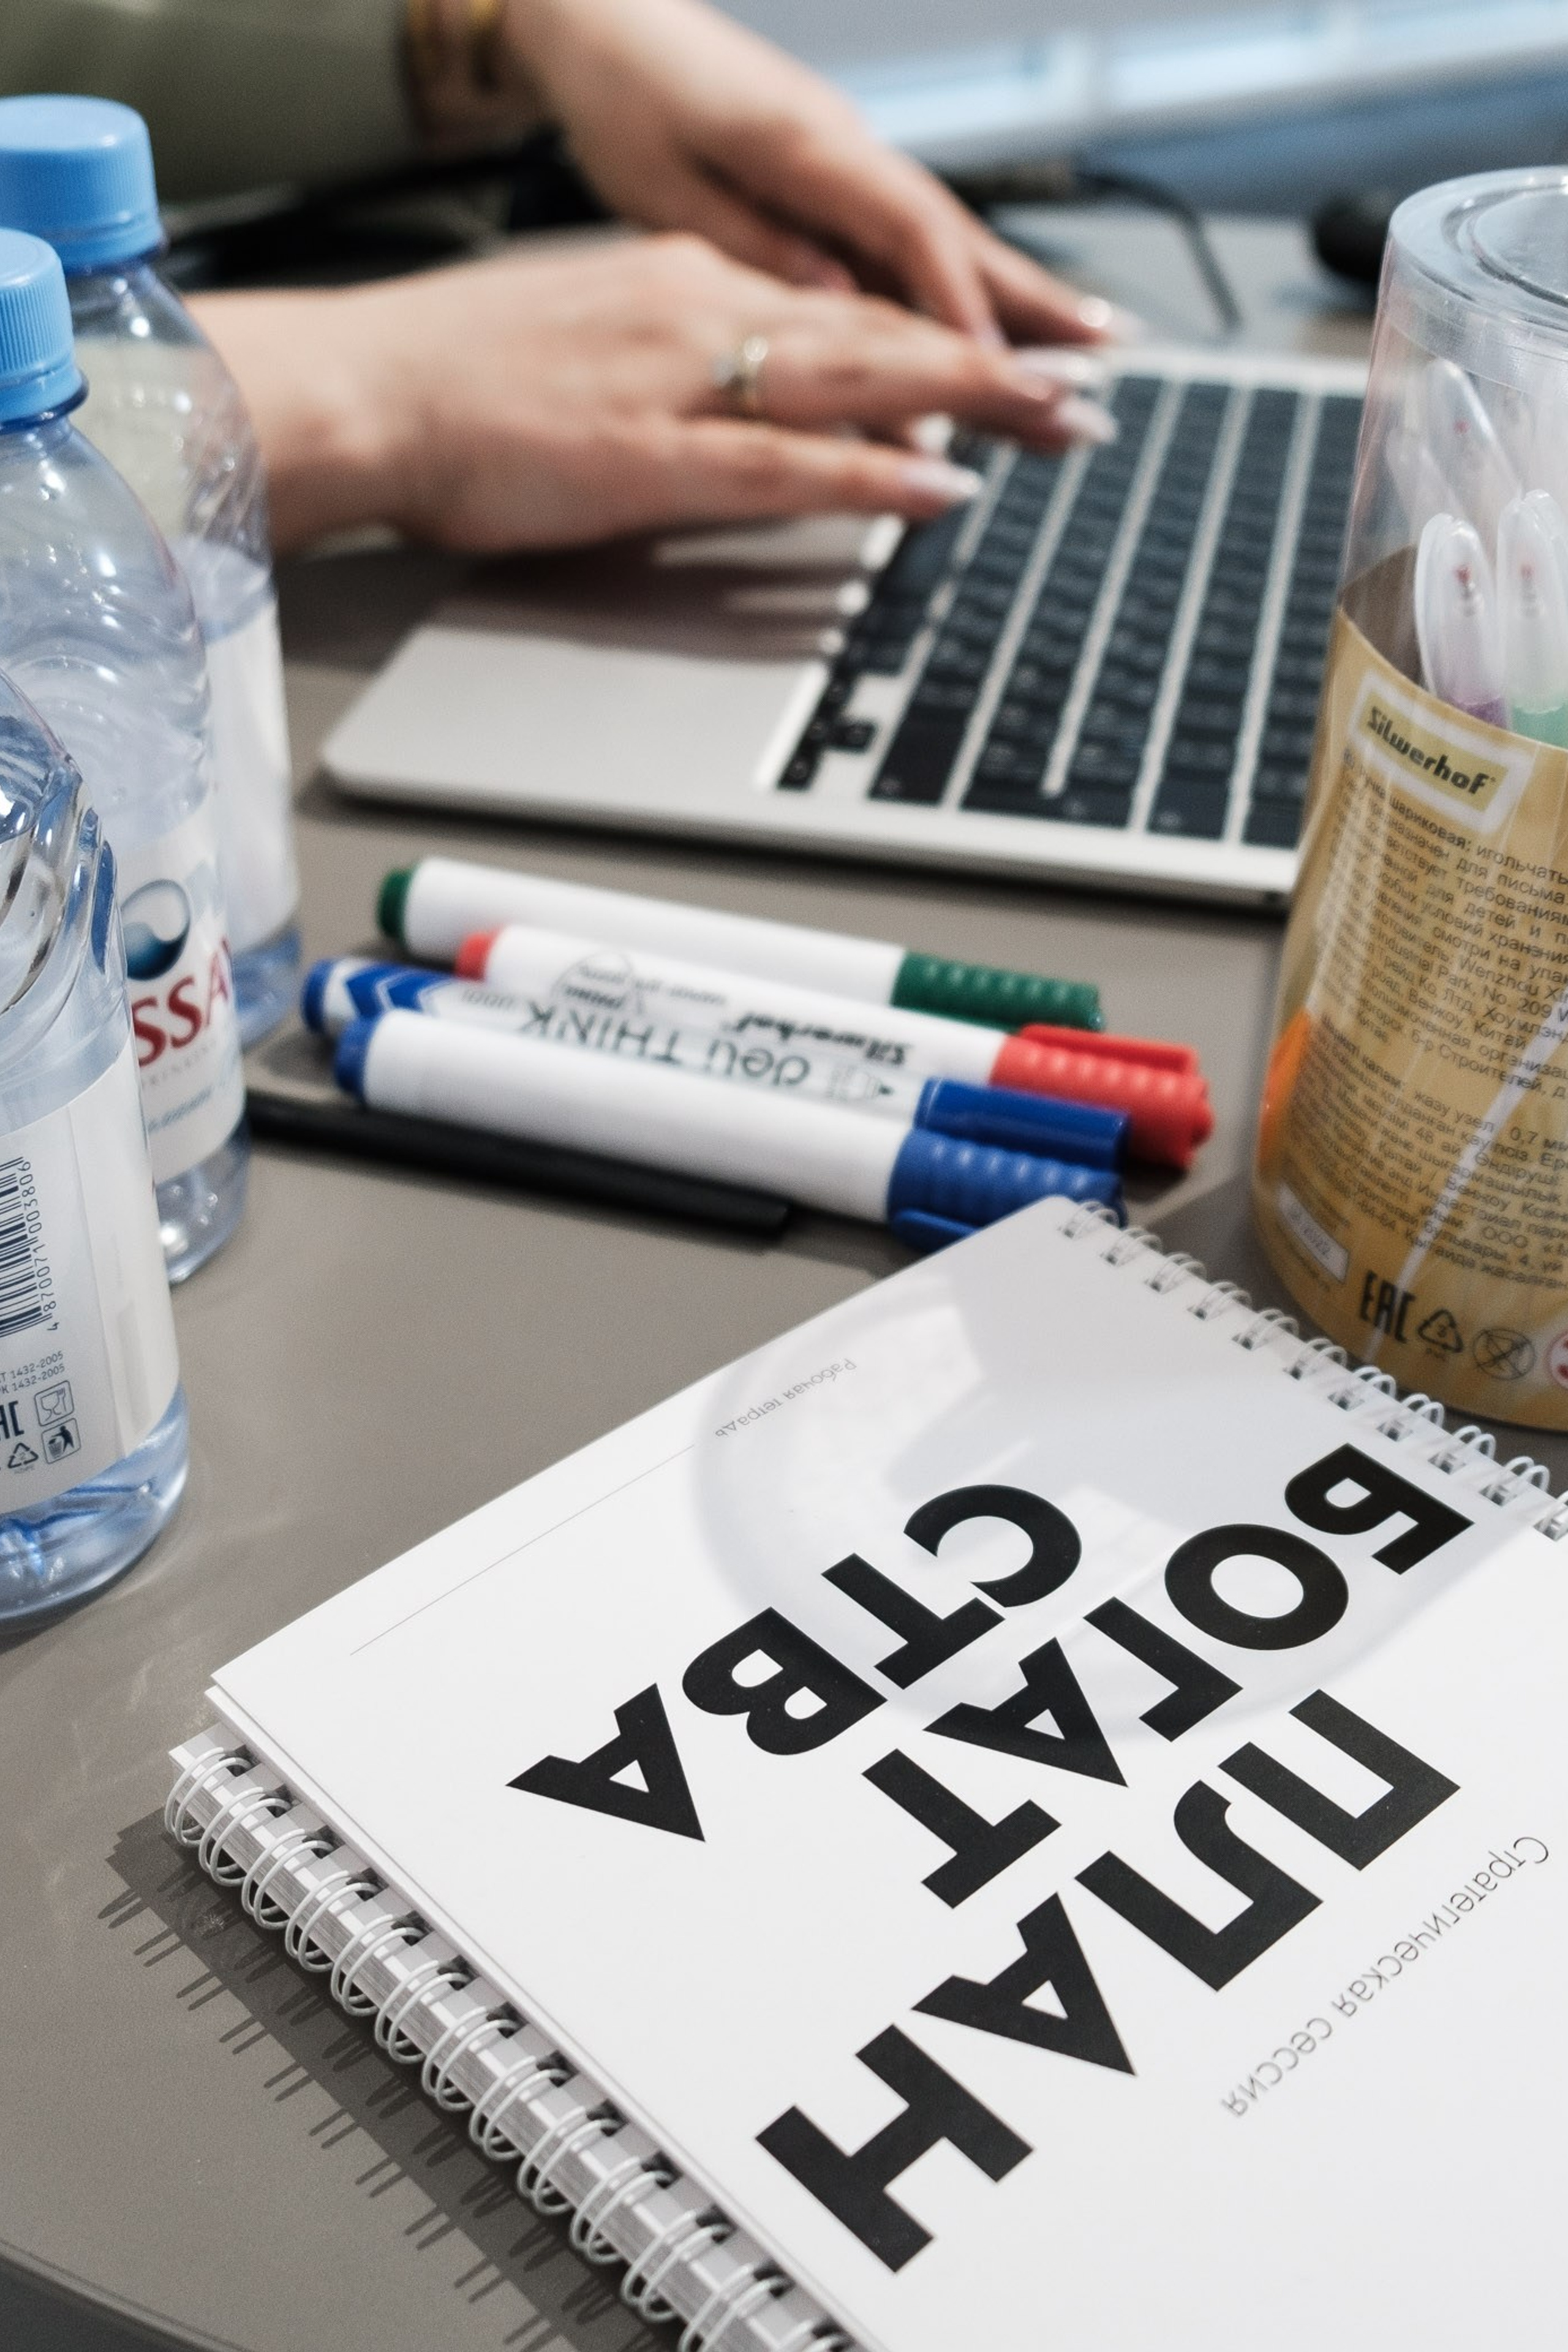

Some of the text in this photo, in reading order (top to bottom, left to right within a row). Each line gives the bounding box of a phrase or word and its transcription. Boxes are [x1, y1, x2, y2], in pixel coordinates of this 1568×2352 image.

[1367, 704, 1490, 795] Silwerhof
[519, 1000, 682, 1066] THINK
[1517, 997, 1553, 1019] 209
[11, 1350, 64, 1379] 1432-2005
[12, 1363, 66, 1392] 1432-2005
[714, 1358, 858, 1438] Рабочая тетрадь
[505, 1483, 1083, 1844] СТВА
[861, 1442, 1476, 1910] БОГАТ
[754, 1689, 1461, 2275] ПЛАН
[1219, 1836, 1550, 2117] Стратегическая сессия
